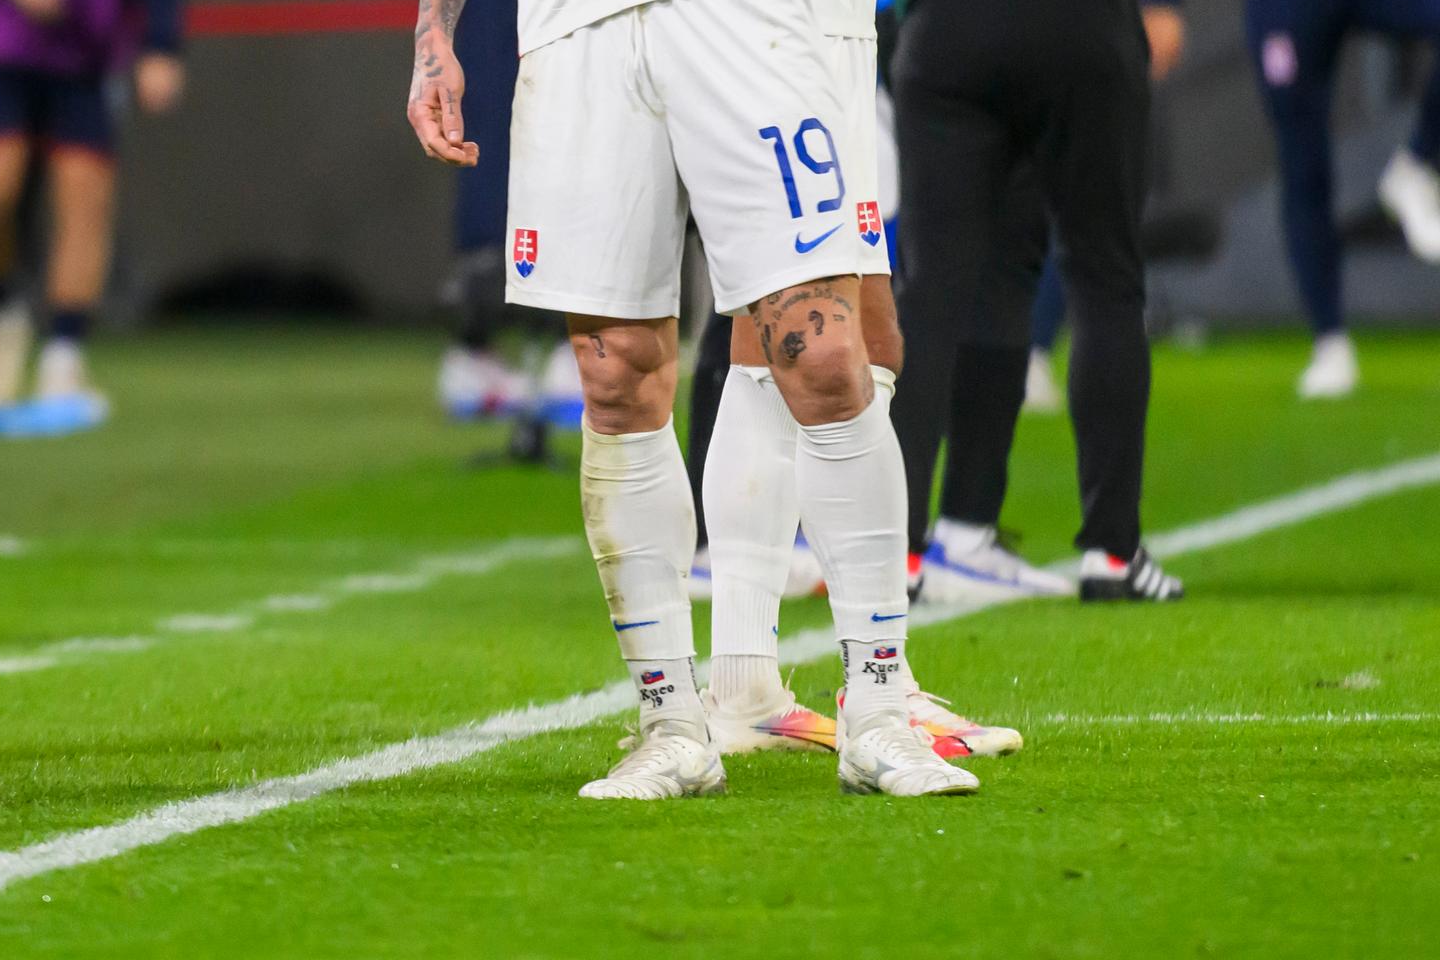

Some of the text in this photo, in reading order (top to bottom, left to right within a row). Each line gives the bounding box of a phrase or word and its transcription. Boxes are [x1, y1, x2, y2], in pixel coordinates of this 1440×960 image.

[759, 117, 846, 220] 19
[874, 672, 887, 684] 19
[651, 696, 663, 709] 19
